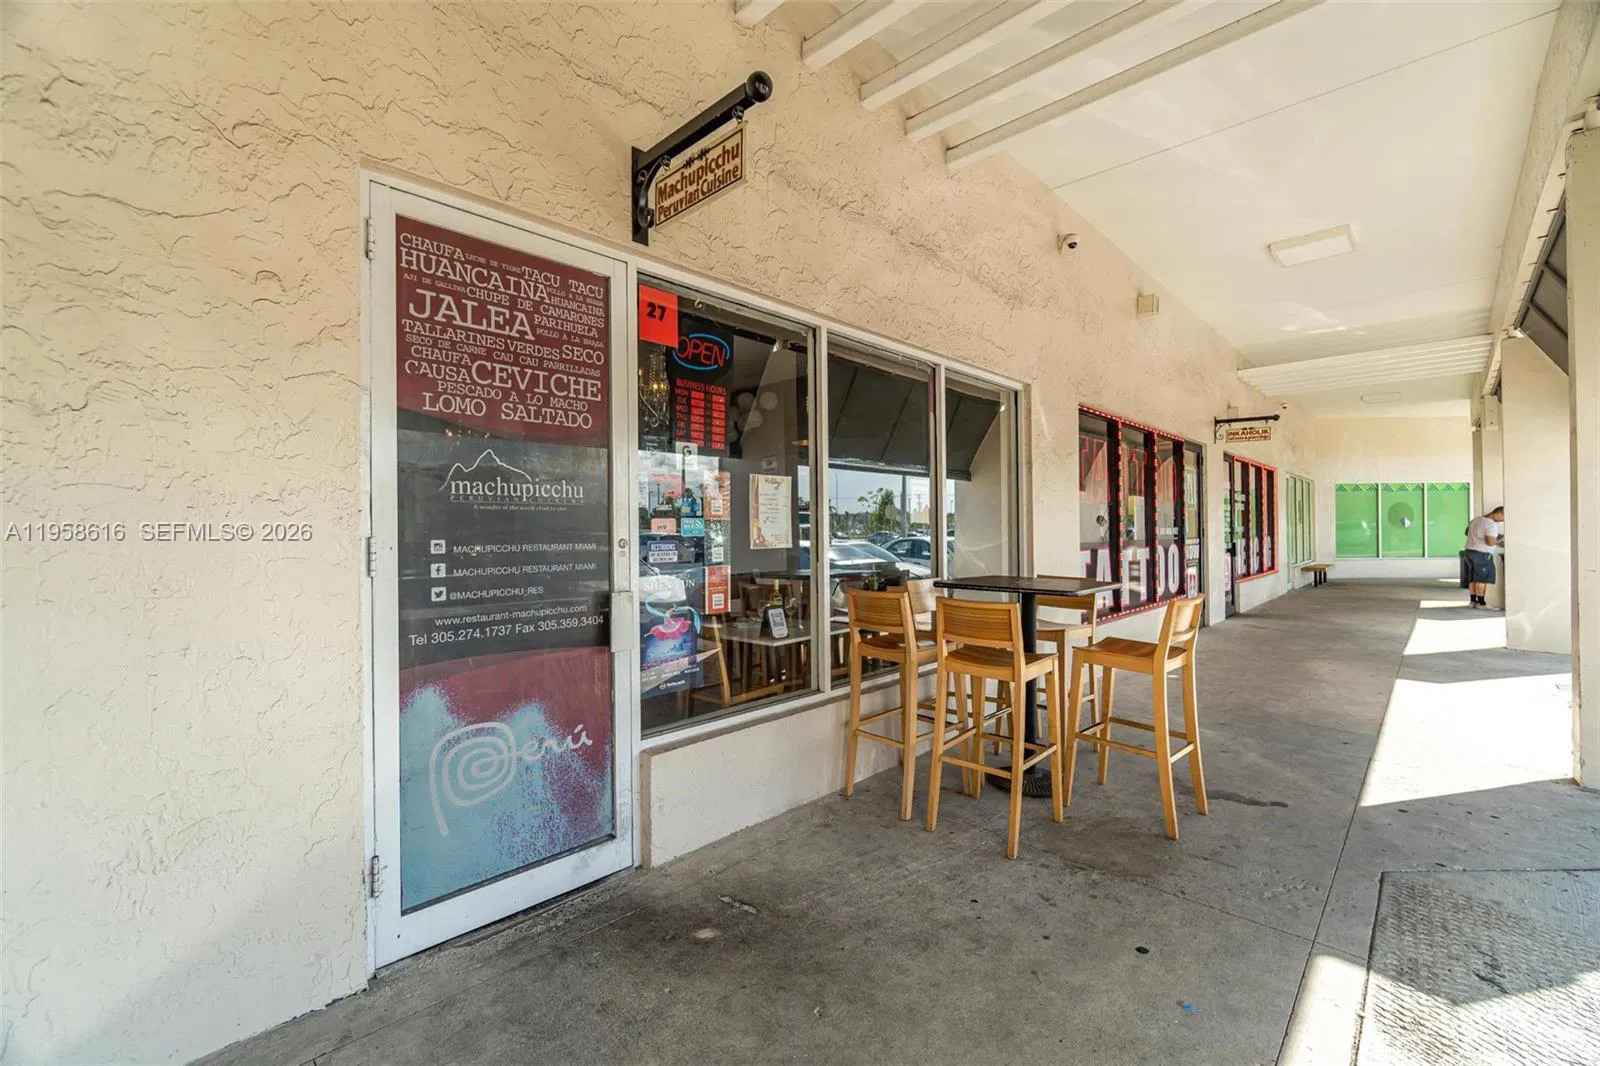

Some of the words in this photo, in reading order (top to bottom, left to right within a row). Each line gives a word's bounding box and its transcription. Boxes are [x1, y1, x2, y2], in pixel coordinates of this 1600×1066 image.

[658, 143, 739, 206] Machupicchu
[658, 188, 700, 221] Peruvian
[701, 165, 738, 196] Cuisine
[400, 232, 465, 262] CHAUFA
[522, 266, 560, 287] TACU
[568, 279, 604, 299] TACU
[400, 247, 550, 304] HUANCAINA
[403, 272, 417, 281] AJI
[422, 277, 432, 285] DE
[466, 286, 510, 306] CHUPE
[517, 299, 533, 311] DE
[540, 306, 604, 328] CAMARONES
[409, 288, 535, 340] JALEA
[534, 314, 598, 338] PARIHUELA
[551, 296, 604, 318] HUANCAINA
[646, 302, 666, 322] 27
[402, 319, 505, 349] TALLARINES
[507, 341, 560, 361] VERDES
[562, 345, 604, 365] SECO
[405, 334, 432, 346] SECO
[438, 339, 450, 348] DE
[456, 343, 486, 356] CARNE
[493, 352, 514, 362] CAU
[519, 356, 539, 367] CAU
[543, 360, 600, 376] PARRILLADAS
[411, 346, 472, 366] CHAUFA
[675, 336, 726, 368] OPEN
[405, 360, 472, 384] CAUSA
[472, 360, 601, 401] CEVICHE
[676, 378, 704, 391] BUSINESS
[706, 384, 726, 394] HOURS
[422, 392, 486, 416] LOMO
[501, 404, 592, 428] SALTADO
[438, 381, 502, 400] PESCADO
[510, 392, 518, 402] A
[527, 394, 542, 406] LO
[550, 398, 588, 412] MACHO
[450, 476, 584, 501] machupicchu
[453, 544, 520, 554] MACHUPICCHU
[522, 544, 573, 552] RESTAURANT
[453, 566, 520, 576] MACHUPICCHU
[522, 564, 574, 574] RESTAURANT
[575, 563, 597, 571] MIAMI
[450, 586, 544, 600] @MACHUPICCHU_RES
[643, 580, 672, 591] SHEN
[435, 604, 588, 626] www.restaurant-machupicchu.com
[409, 634, 427, 646] Tel
[431, 624, 511, 644] 305.274.1737
[516, 623, 534, 634] Fax
[538, 616, 604, 631] 305.359.3404
